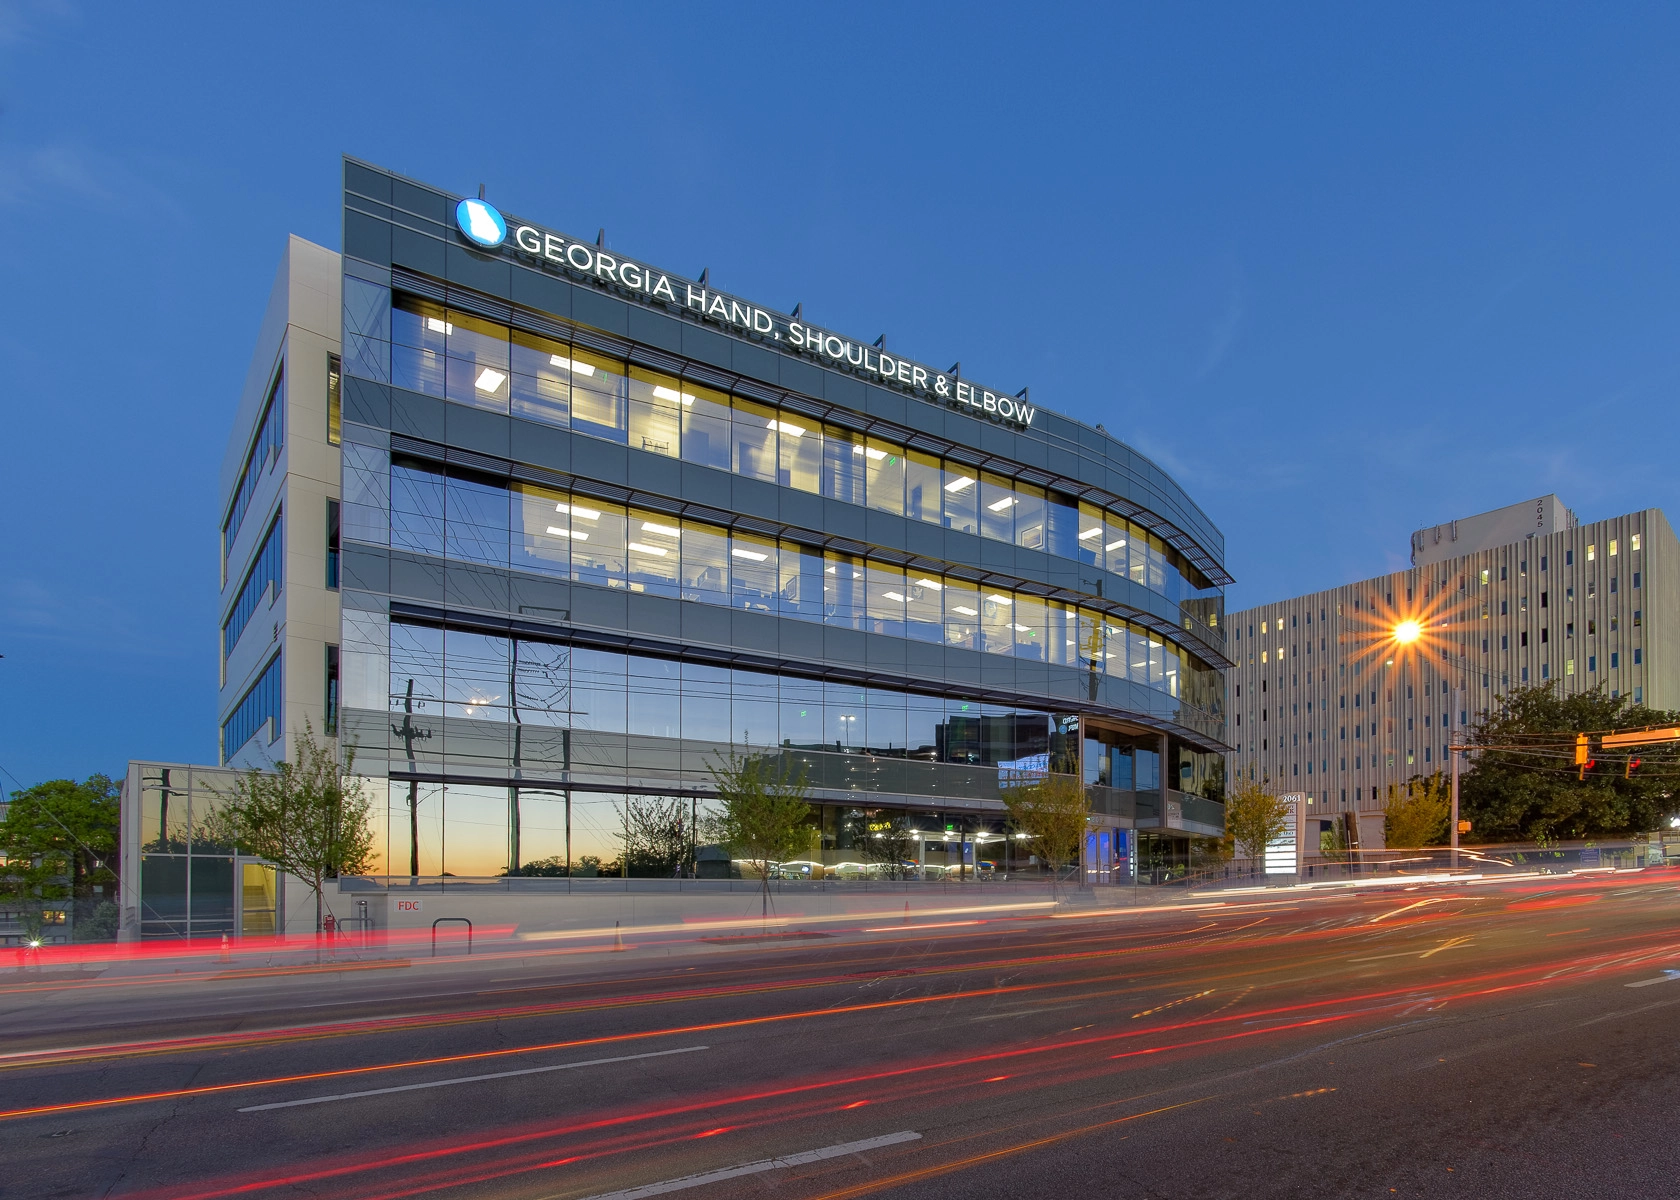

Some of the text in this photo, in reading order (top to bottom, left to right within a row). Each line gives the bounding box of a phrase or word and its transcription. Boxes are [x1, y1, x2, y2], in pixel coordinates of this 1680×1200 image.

[515, 226, 1035, 425] GEORGIA HAND, SHOULDER & ELBOW
[1282, 794, 1301, 803] 2061
[397, 901, 419, 911] FDC
